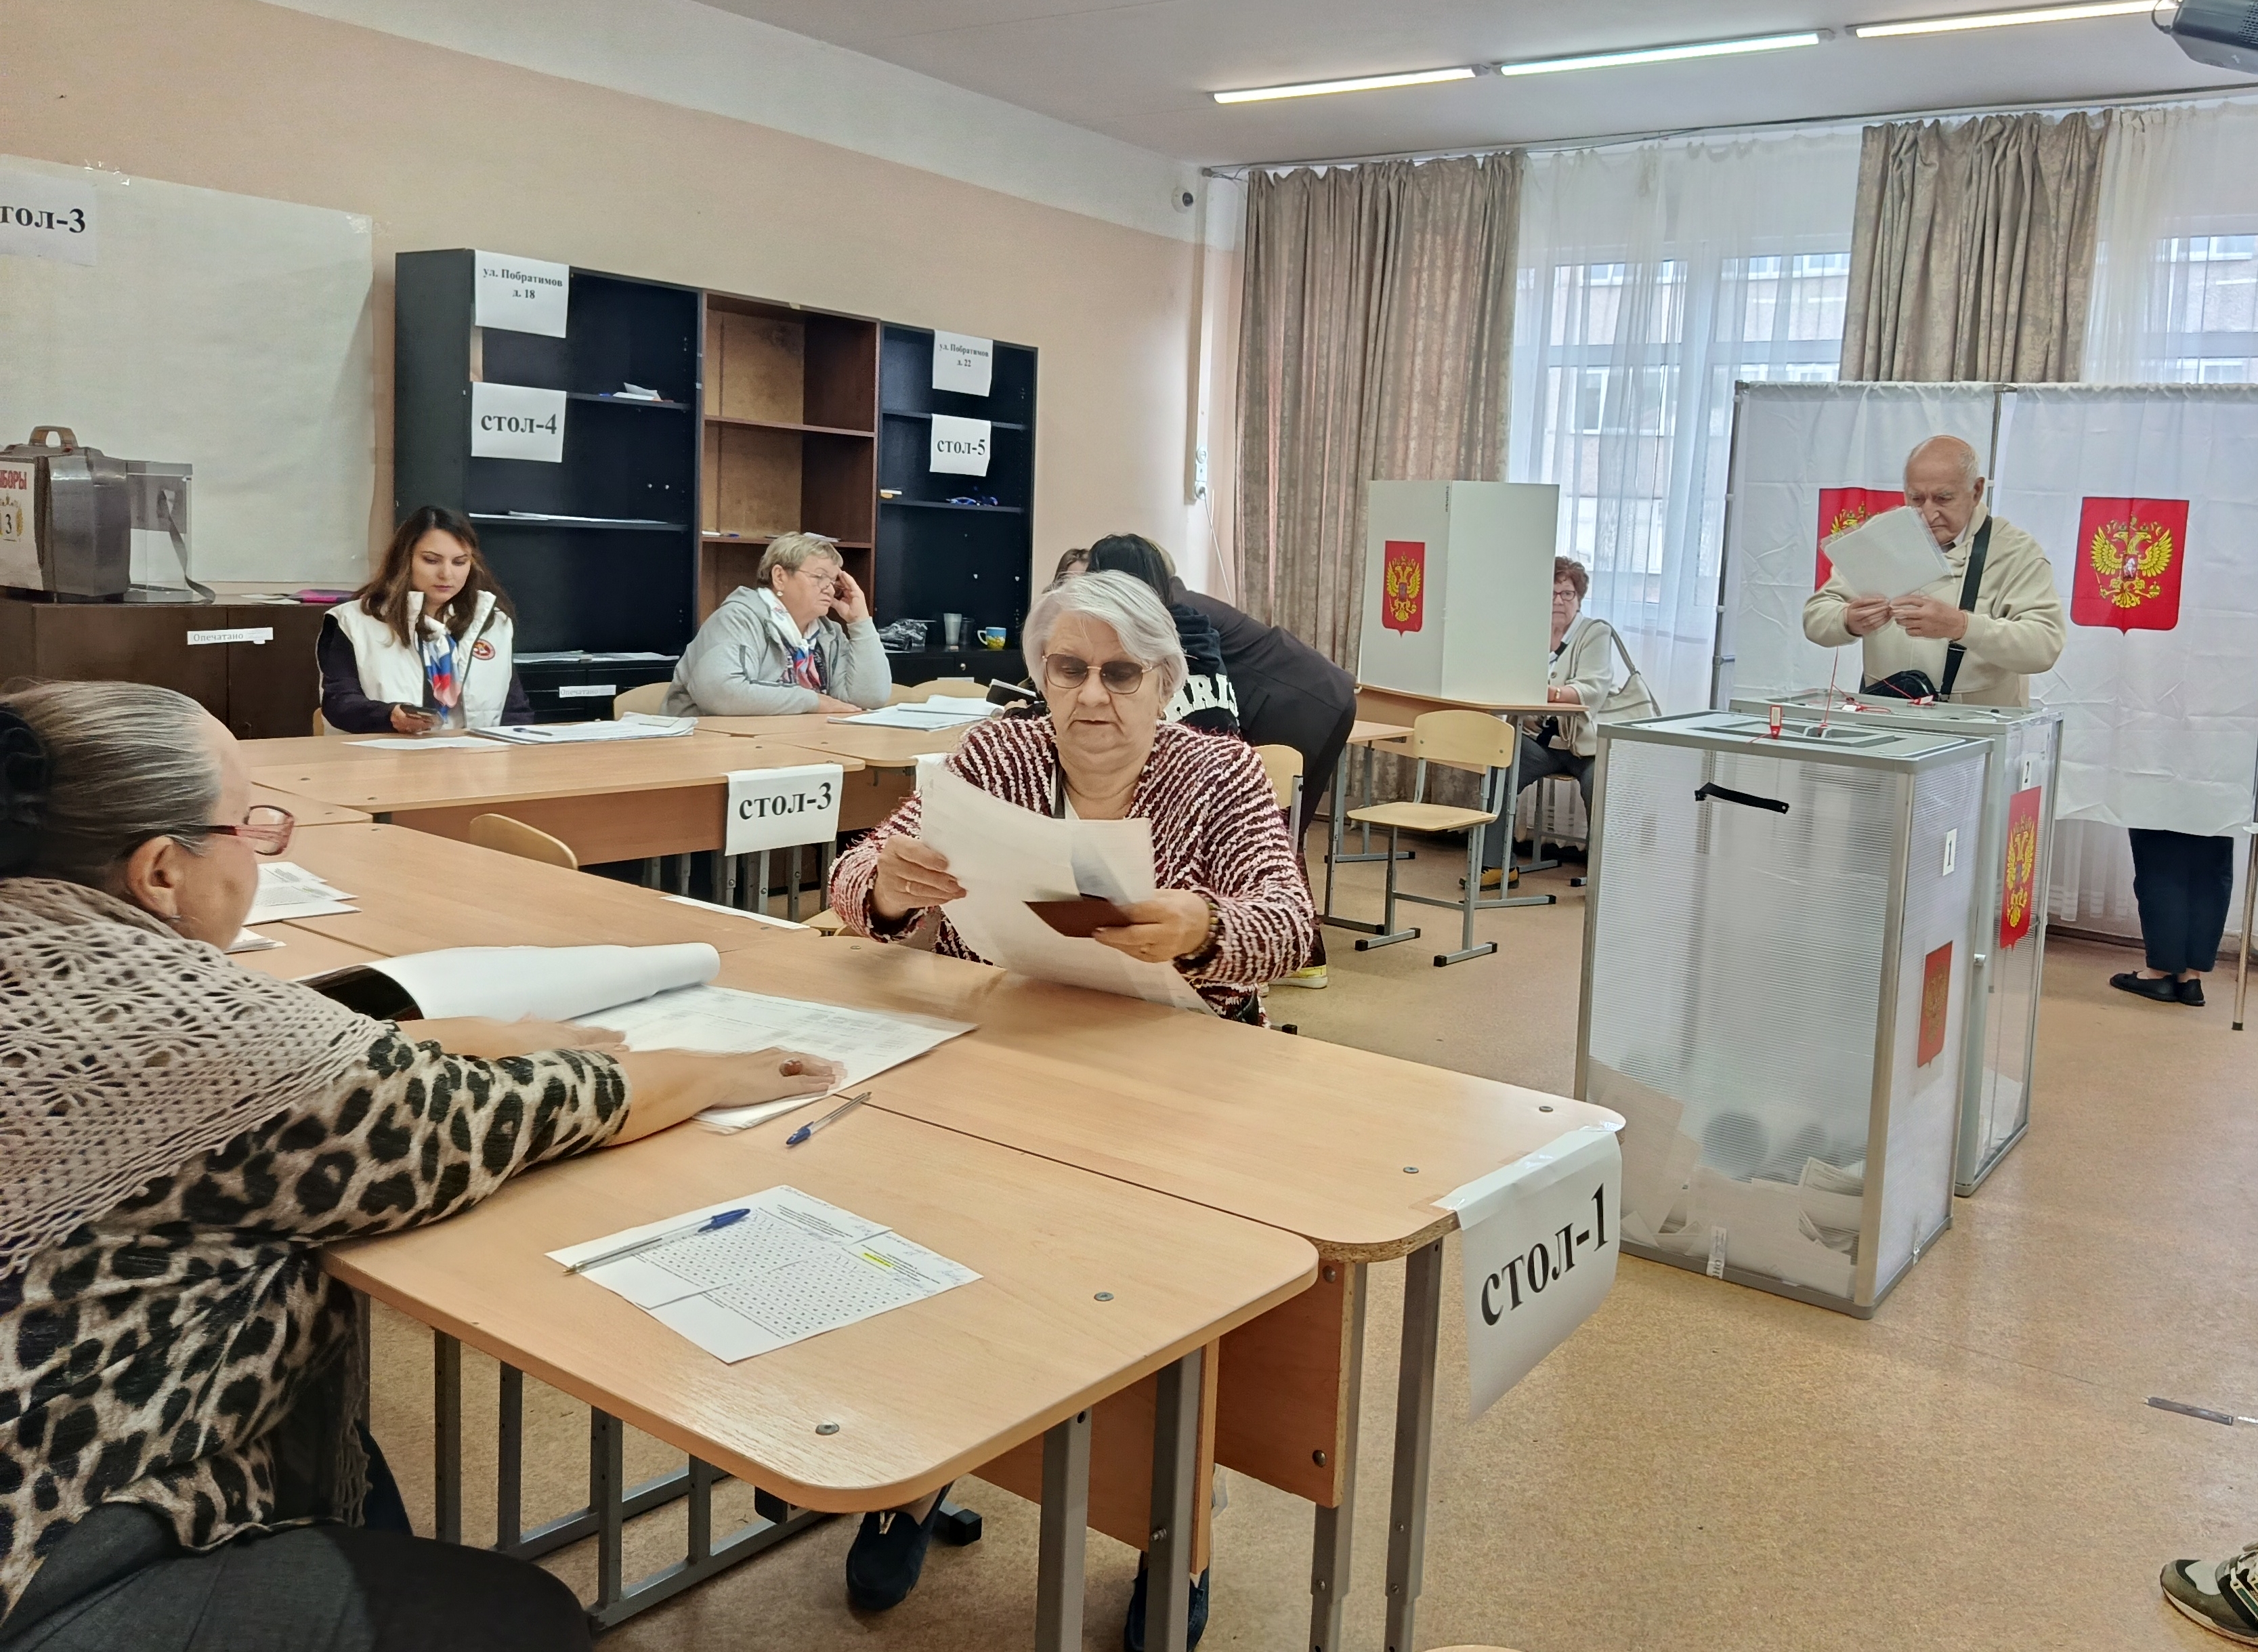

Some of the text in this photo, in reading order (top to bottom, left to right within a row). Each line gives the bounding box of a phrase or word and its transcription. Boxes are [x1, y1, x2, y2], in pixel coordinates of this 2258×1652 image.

[0, 205, 86, 234] тол-3
[483, 268, 563, 287] ул. Побратимов
[512, 289, 536, 299] д. 18
[950, 343, 989, 358] Побратимов
[964, 358, 972, 367] 22
[480, 413, 557, 435] стол-4
[937, 438, 986, 456] стол-5
[0, 469, 27, 490] БОРЫ
[193, 633, 244, 642] Опечатано
[560, 688, 599, 696] Опечатано
[2024, 761, 2030, 784] 2
[739, 782, 832, 820] стол-3
[1946, 840, 1953, 867] 1
[1481, 1183, 1609, 1326] стол-1
